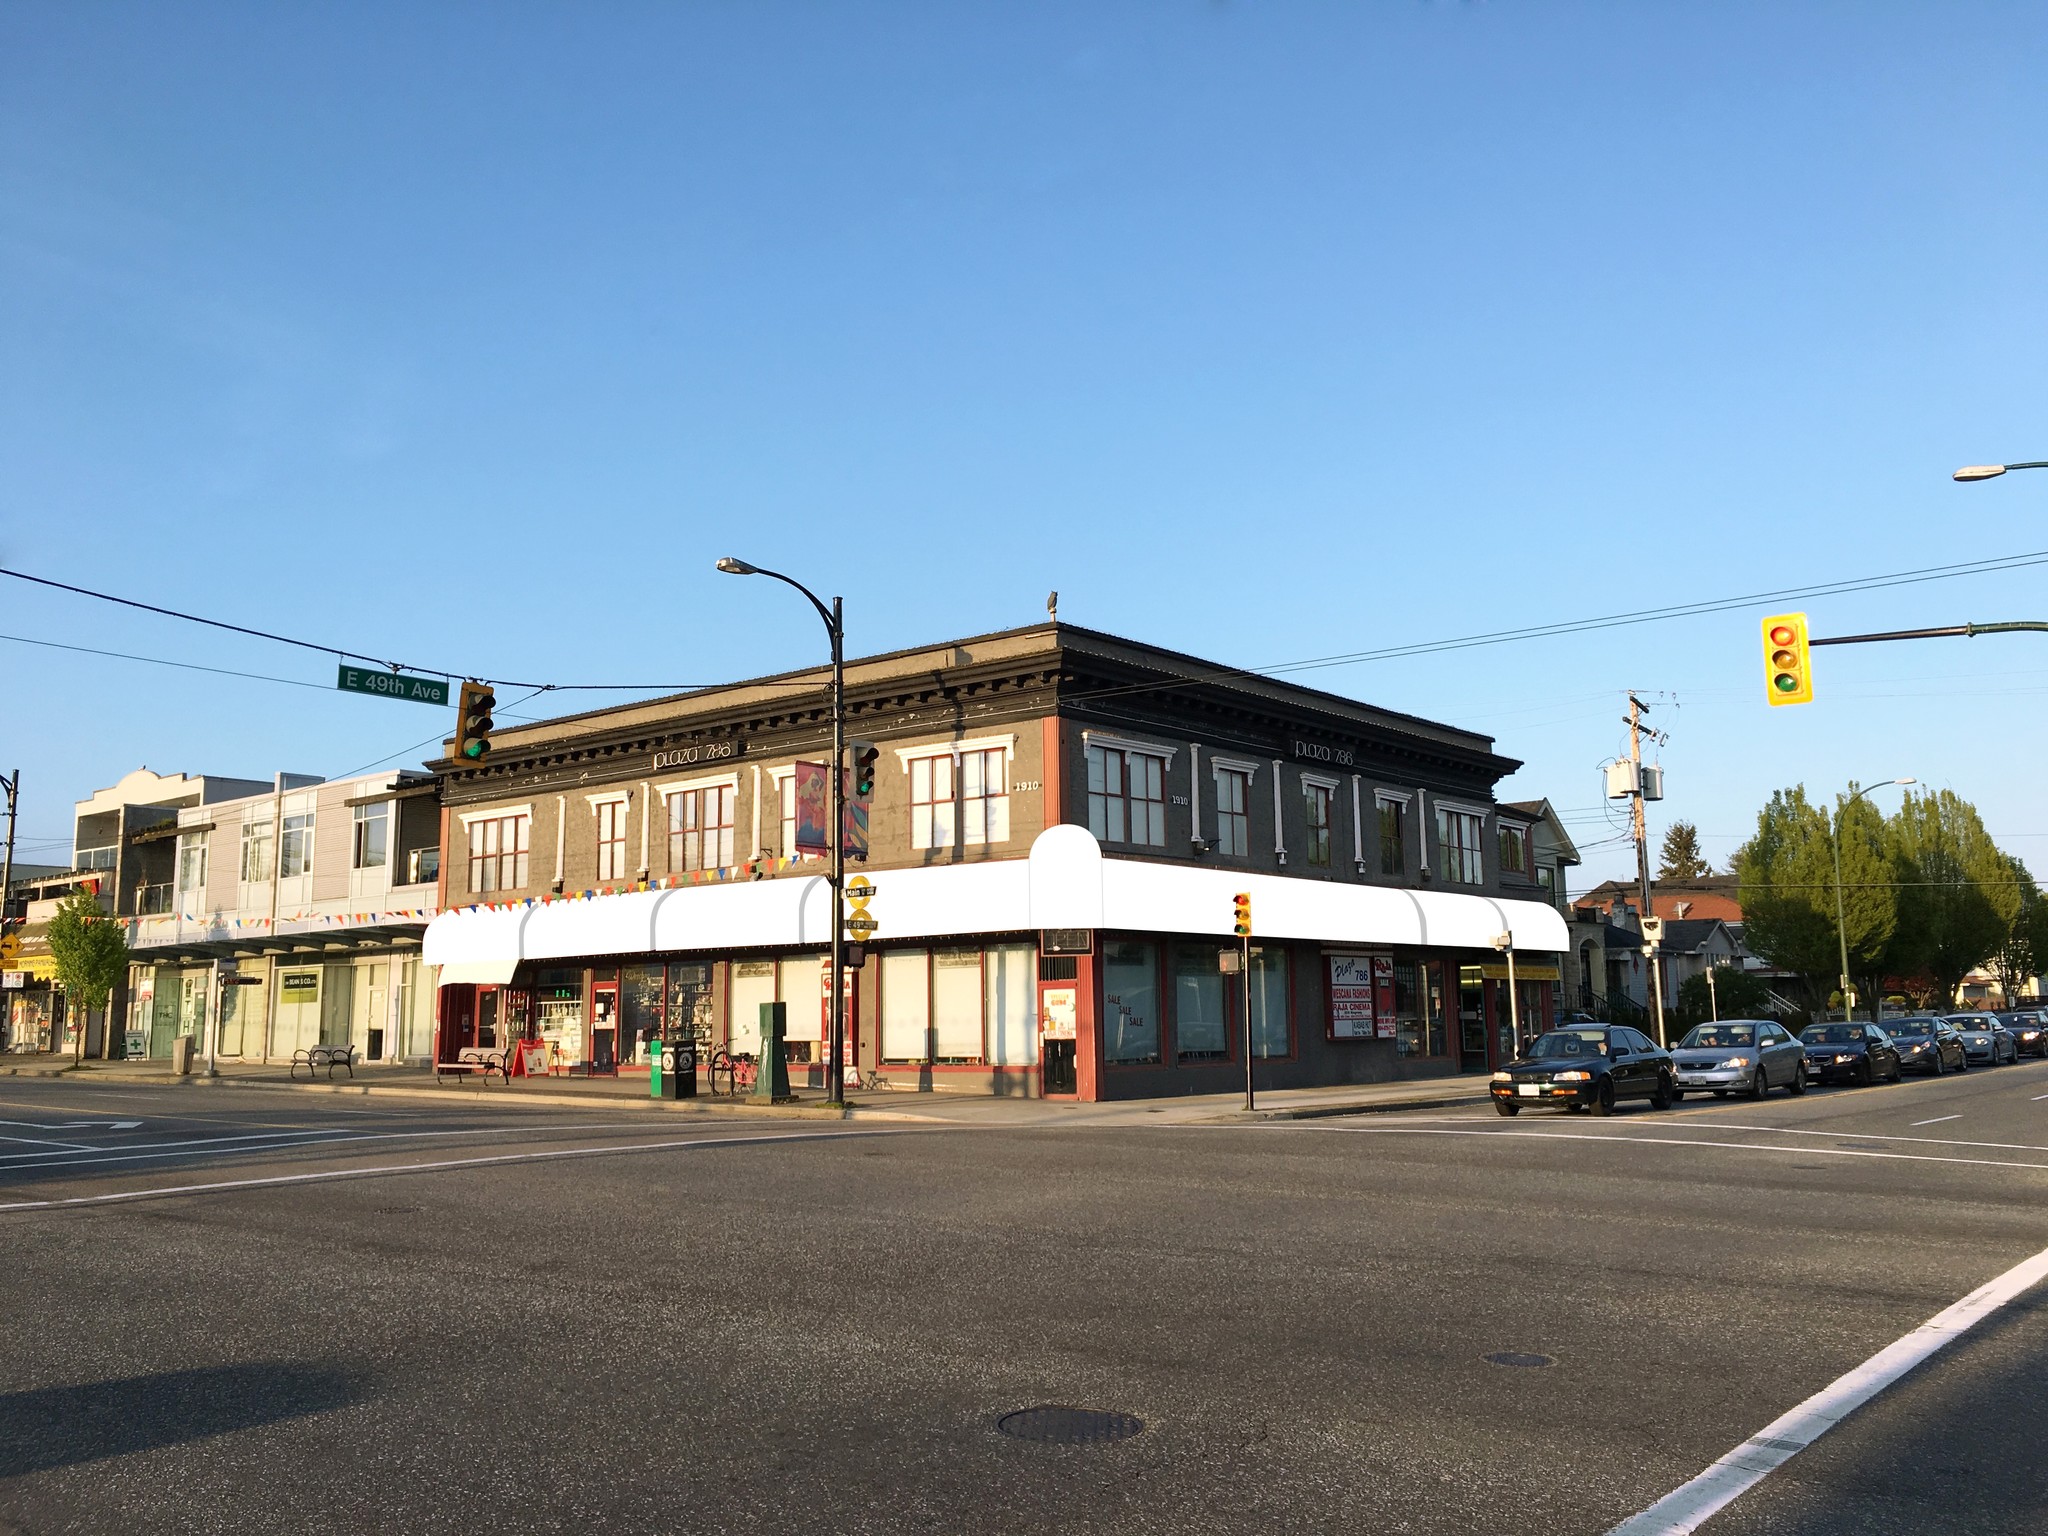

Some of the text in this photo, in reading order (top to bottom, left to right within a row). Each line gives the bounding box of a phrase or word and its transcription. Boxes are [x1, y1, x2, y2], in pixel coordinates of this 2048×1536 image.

[346, 671, 441, 700] E 49th Ave
[706, 741, 731, 760] 786
[1335, 748, 1353, 766] 786
[1015, 780, 1039, 792] 1910
[1172, 795, 1189, 806] 1910
[847, 888, 861, 897] Main
[1335, 958, 1369, 982] Plaza 786
[1107, 994, 1121, 1005] SALE
[1118, 1006, 1132, 1016] SALE
[1333, 1003, 1371, 1011] RAJA CINEMA
[1129, 1017, 1143, 1027] SALE
